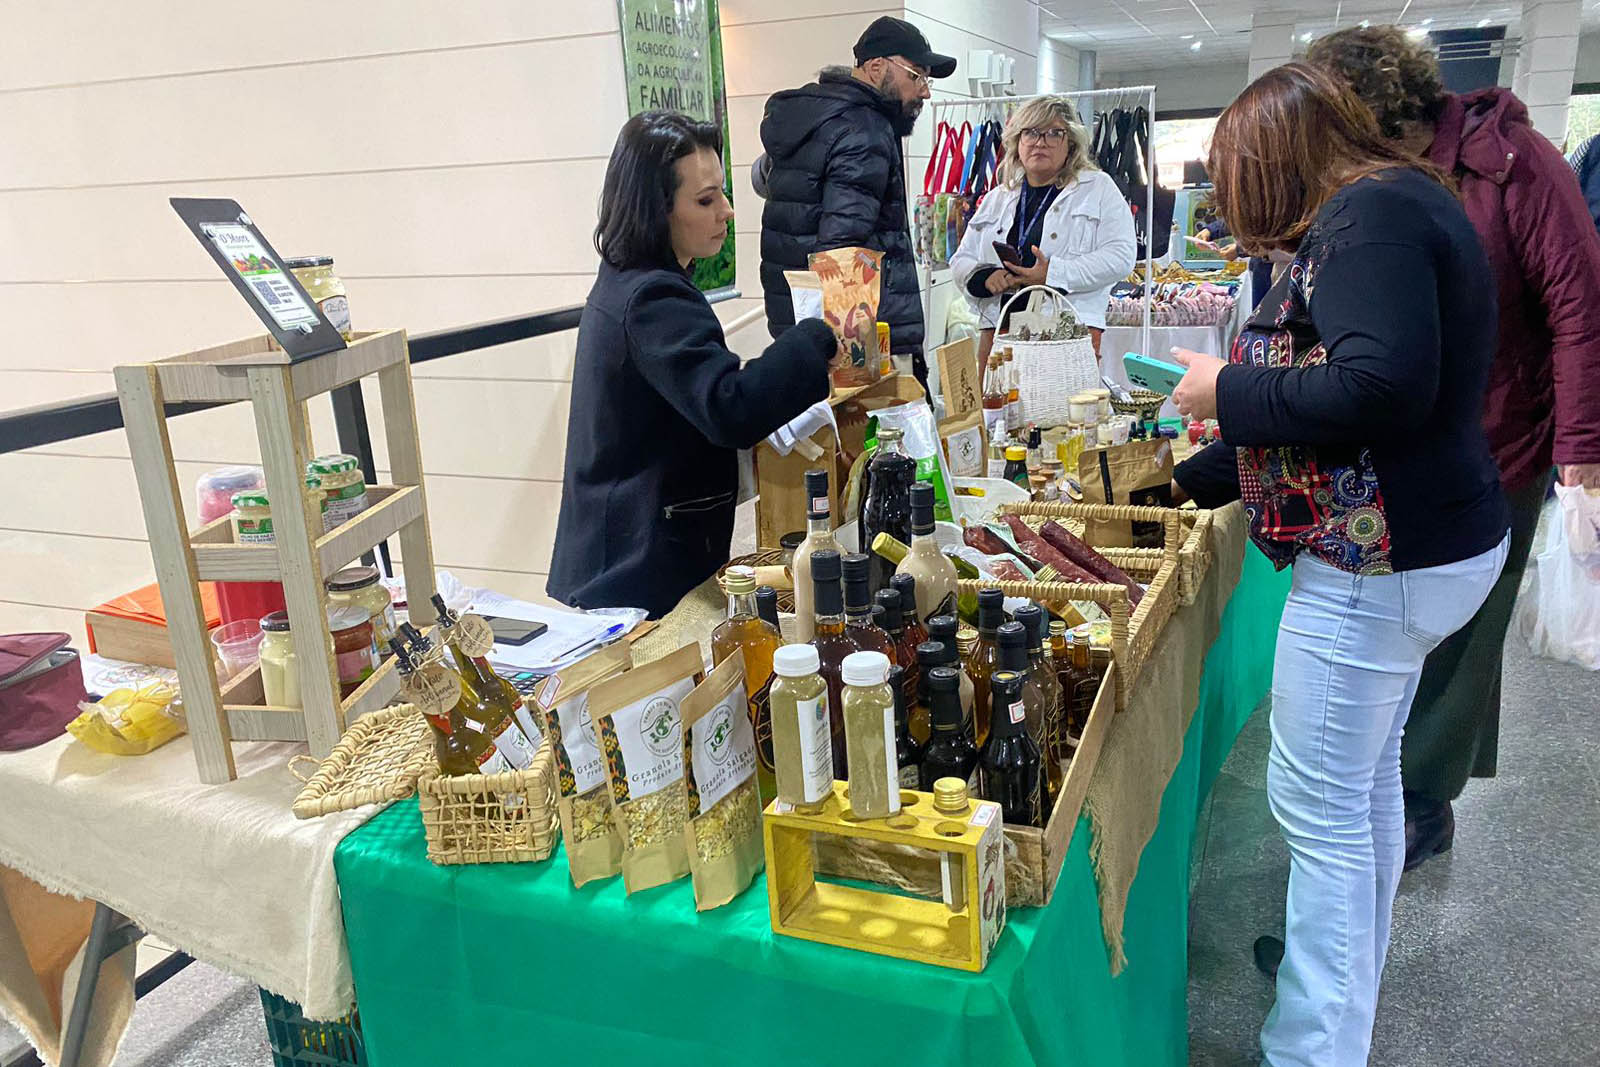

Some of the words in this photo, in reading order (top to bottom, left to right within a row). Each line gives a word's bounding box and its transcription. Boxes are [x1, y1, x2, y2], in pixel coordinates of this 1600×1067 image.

[635, 11, 700, 40] ALIMENTOS
[636, 41, 702, 63] AGROECOLÓG
[637, 63, 650, 77] DA
[653, 65, 703, 82] AGRICULA
[640, 85, 704, 112] FAMILIAR
[631, 760, 671, 782] Granola
[700, 769, 726, 794] Granola
